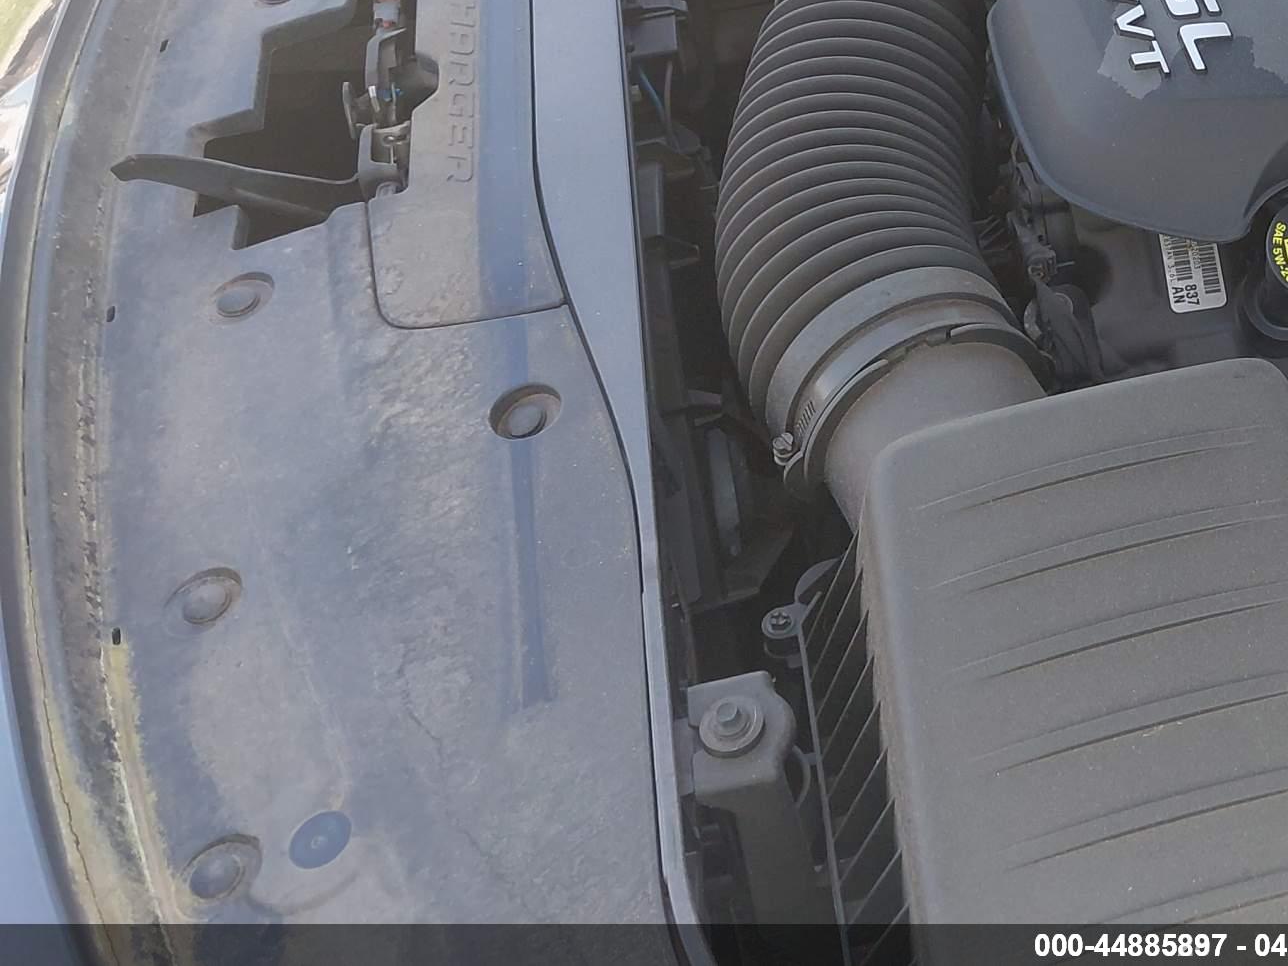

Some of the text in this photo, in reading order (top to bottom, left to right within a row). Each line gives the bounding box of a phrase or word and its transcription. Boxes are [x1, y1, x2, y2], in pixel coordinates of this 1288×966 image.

[1272, 222, 1287, 246] SAE
[1171, 286, 1187, 304] AN
[1184, 283, 1201, 306] 837
